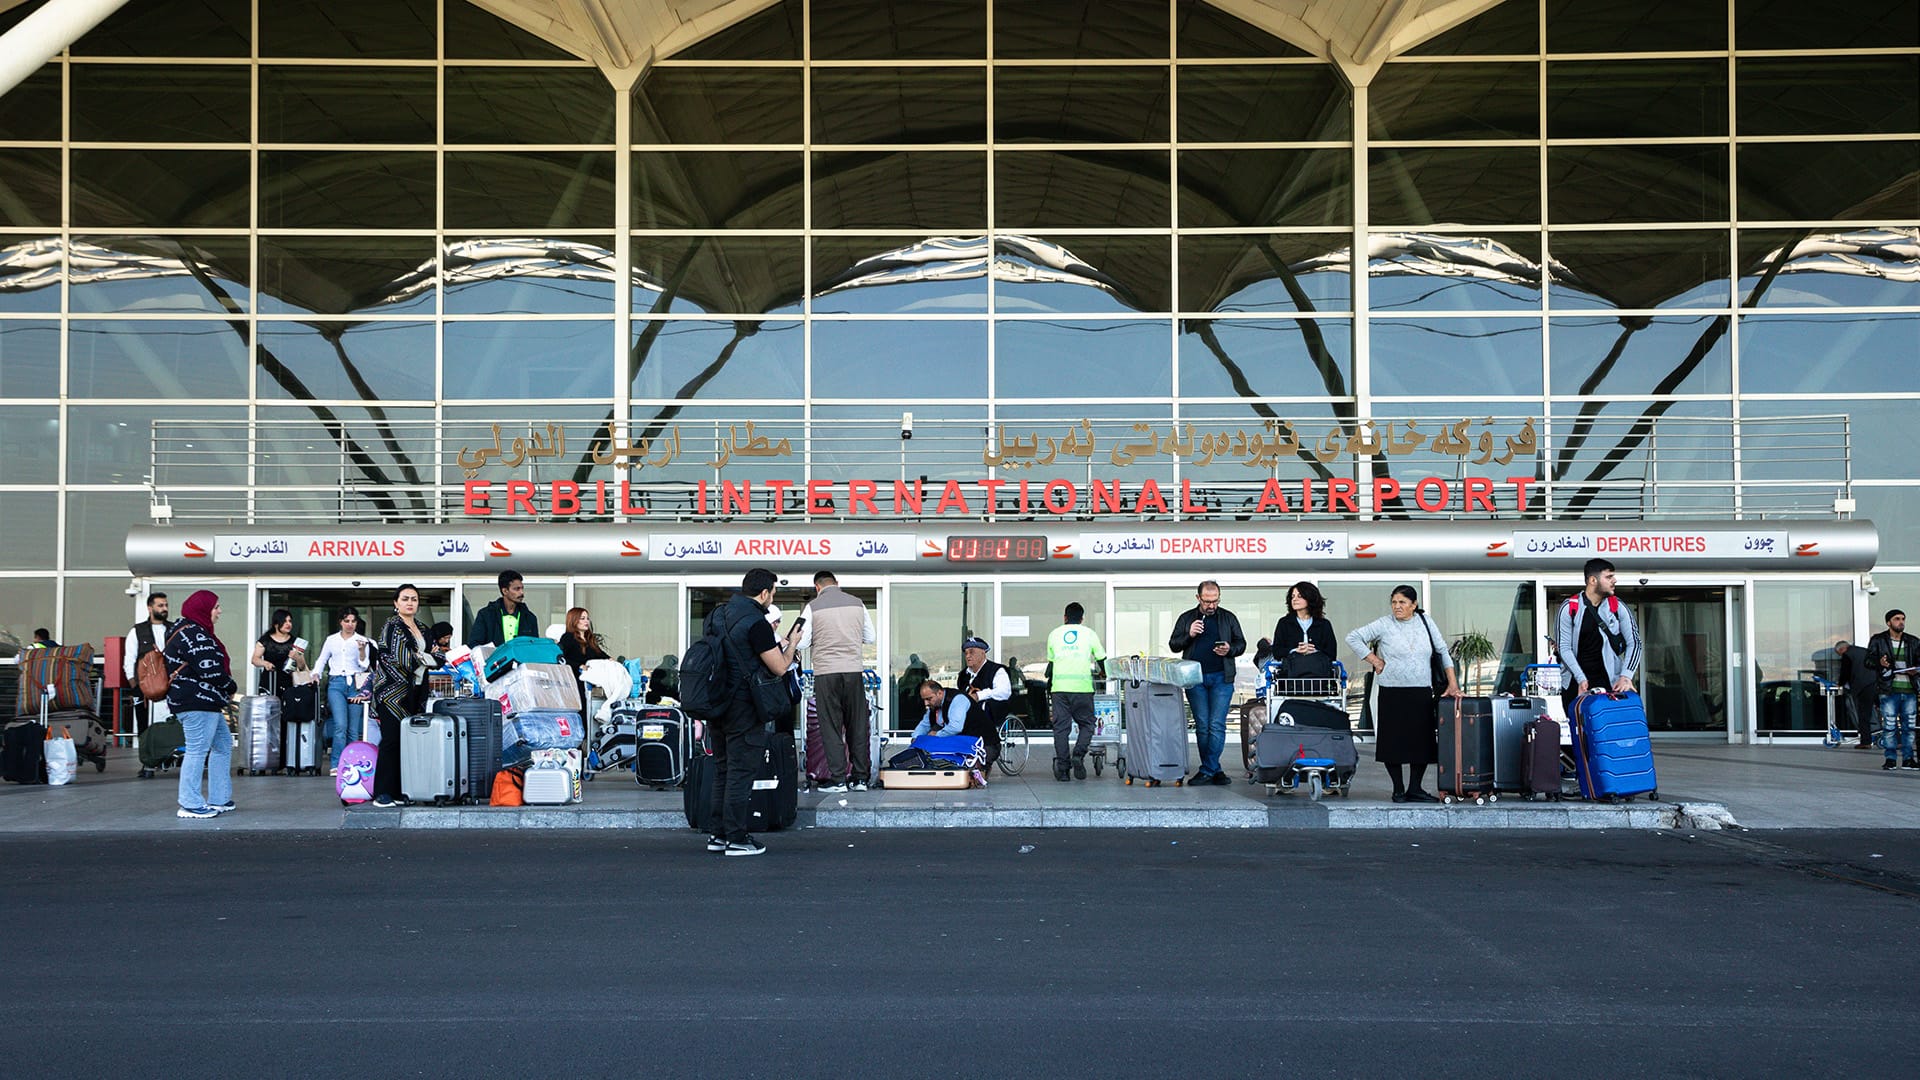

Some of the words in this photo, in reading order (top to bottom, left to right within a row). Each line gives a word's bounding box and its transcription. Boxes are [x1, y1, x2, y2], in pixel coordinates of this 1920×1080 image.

[456, 422, 565, 479] الدولي
[592, 421, 681, 471] اربيل
[706, 420, 792, 469] مطار
[463, 479, 647, 515] ERBIL
[698, 478, 1208, 515] INTERNATIONAL
[1255, 476, 1537, 513] AIRPORT
[230, 540, 288, 558] القادمون
[308, 540, 405, 557] ARRIVALS
[664, 540, 722, 558] القادمون
[734, 539, 831, 556] ARRIVALS
[1092, 538, 1155, 554] المغادرون
[1160, 538, 1267, 554] DEPARTURES
[1526, 536, 1590, 553] المغادرون
[1596, 536, 1706, 553] DEPARTURES
